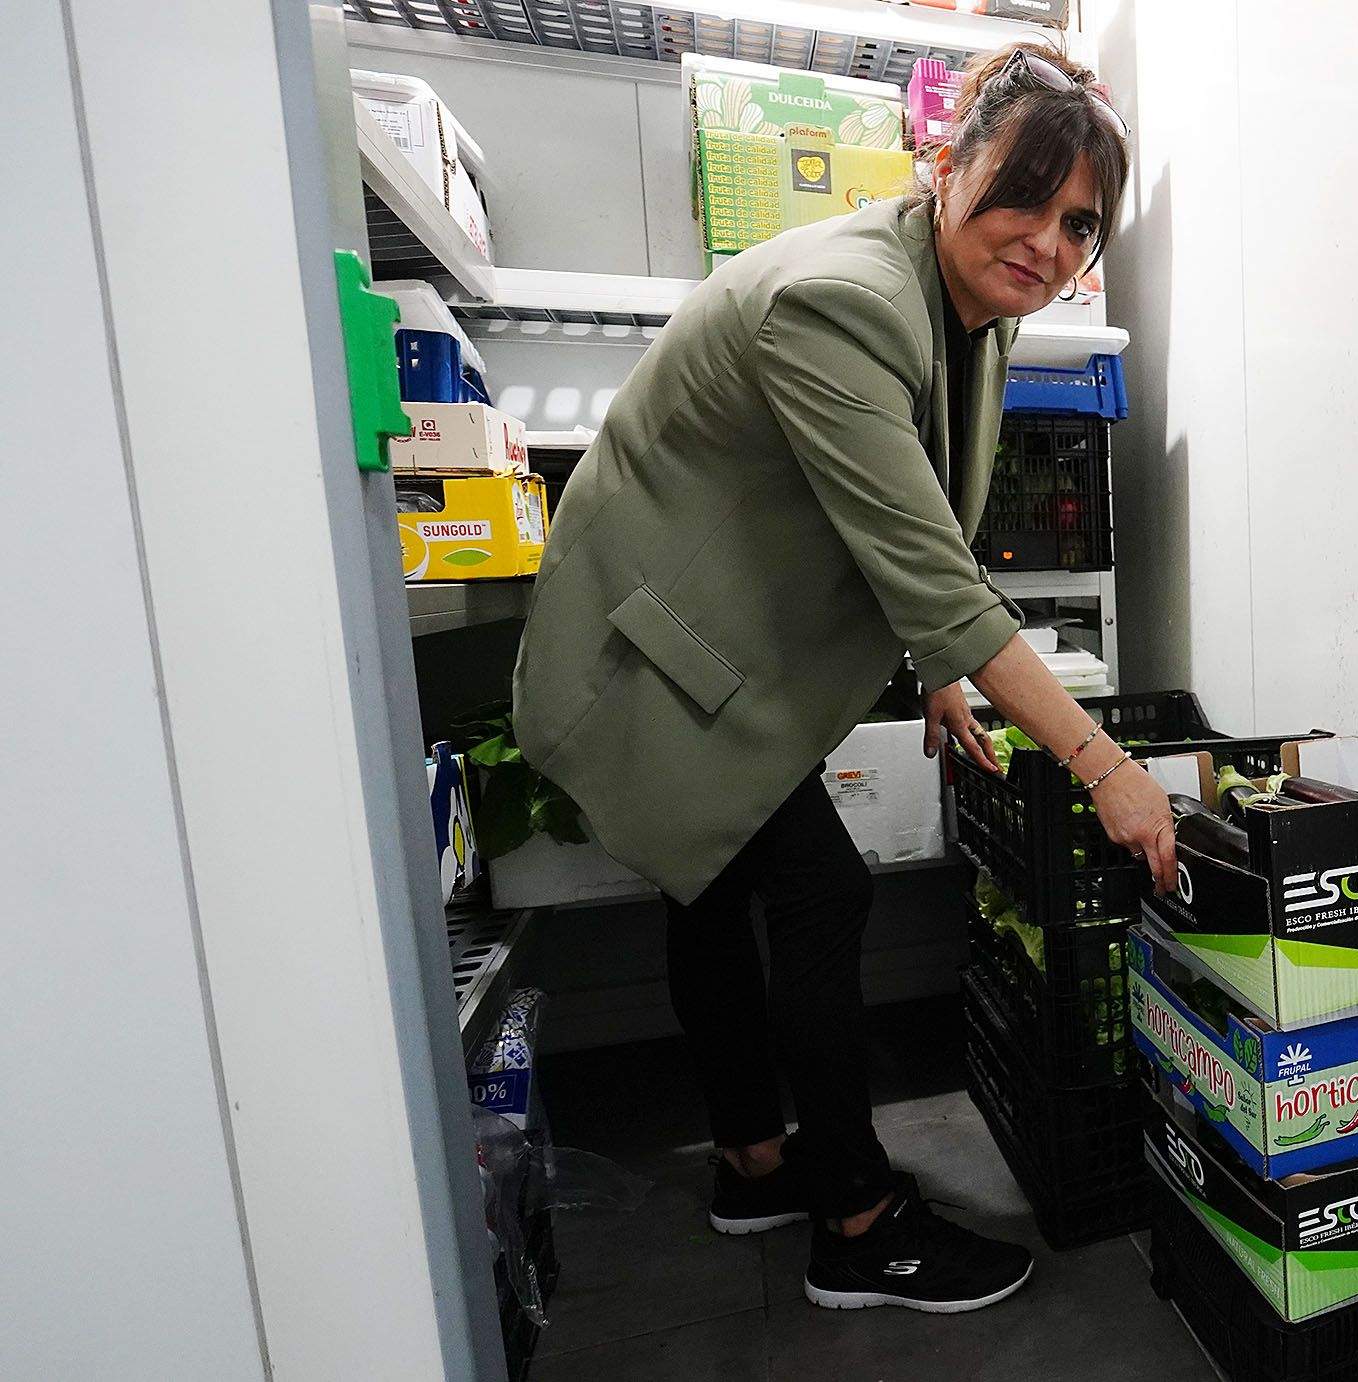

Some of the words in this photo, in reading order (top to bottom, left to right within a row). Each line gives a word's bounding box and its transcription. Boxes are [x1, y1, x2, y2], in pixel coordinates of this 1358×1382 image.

[768, 91, 832, 111] DULCEIDA
[733, 143, 744, 151] de
[734, 153, 744, 162] de
[734, 164, 745, 173] de
[735, 175, 745, 184] de
[735, 186, 746, 196] de
[736, 198, 746, 207] de
[737, 209, 747, 218] de
[737, 219, 747, 229] de
[738, 231, 748, 240] de
[739, 242, 749, 250] de
[423, 524, 482, 537] SUNGOLD
[1286, 914, 1312, 926] ESCO
[1315, 908, 1347, 921] FRESH
[1146, 993, 1234, 1107] horticampo
[1278, 1062, 1312, 1077] FRUPAL
[1300, 1234, 1319, 1245] ESCO
[1320, 1227, 1343, 1239] FRESH
